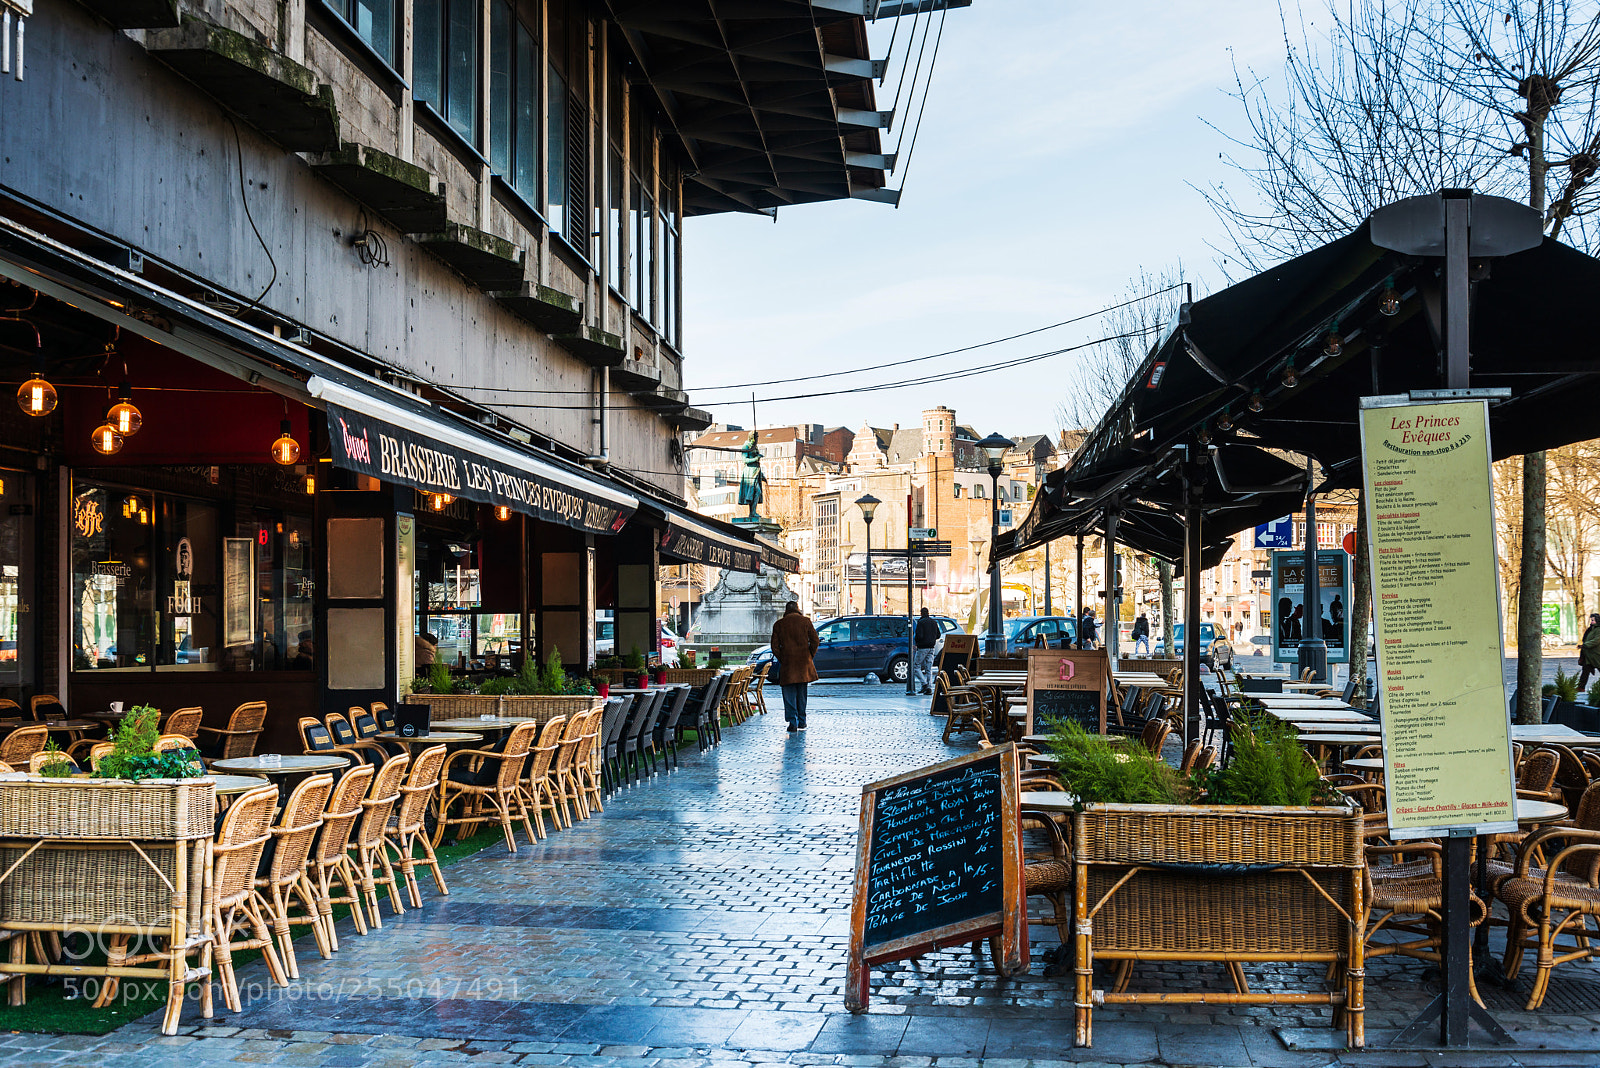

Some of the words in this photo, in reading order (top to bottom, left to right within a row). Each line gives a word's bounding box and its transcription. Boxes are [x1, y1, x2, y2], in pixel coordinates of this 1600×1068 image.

[1391, 417, 1411, 430] Les
[1415, 415, 1460, 428] Princes
[1402, 430, 1451, 446] Evêques
[1383, 440, 1421, 456] Restauration
[1422, 446, 1450, 455] non-stop
[380, 434, 461, 490] BRASSERIE
[462, 460, 492, 493] LES
[492, 469, 542, 508] PRINCES
[543, 487, 584, 520] EVEQUES
[91, 560, 132, 577] Brasserie
[1283, 569, 1297, 577] LA
[1417, 805, 1435, 813] Gaufre
[1436, 804, 1457, 812] Chantilly
[1481, 800, 1508, 809] Milk-shake
